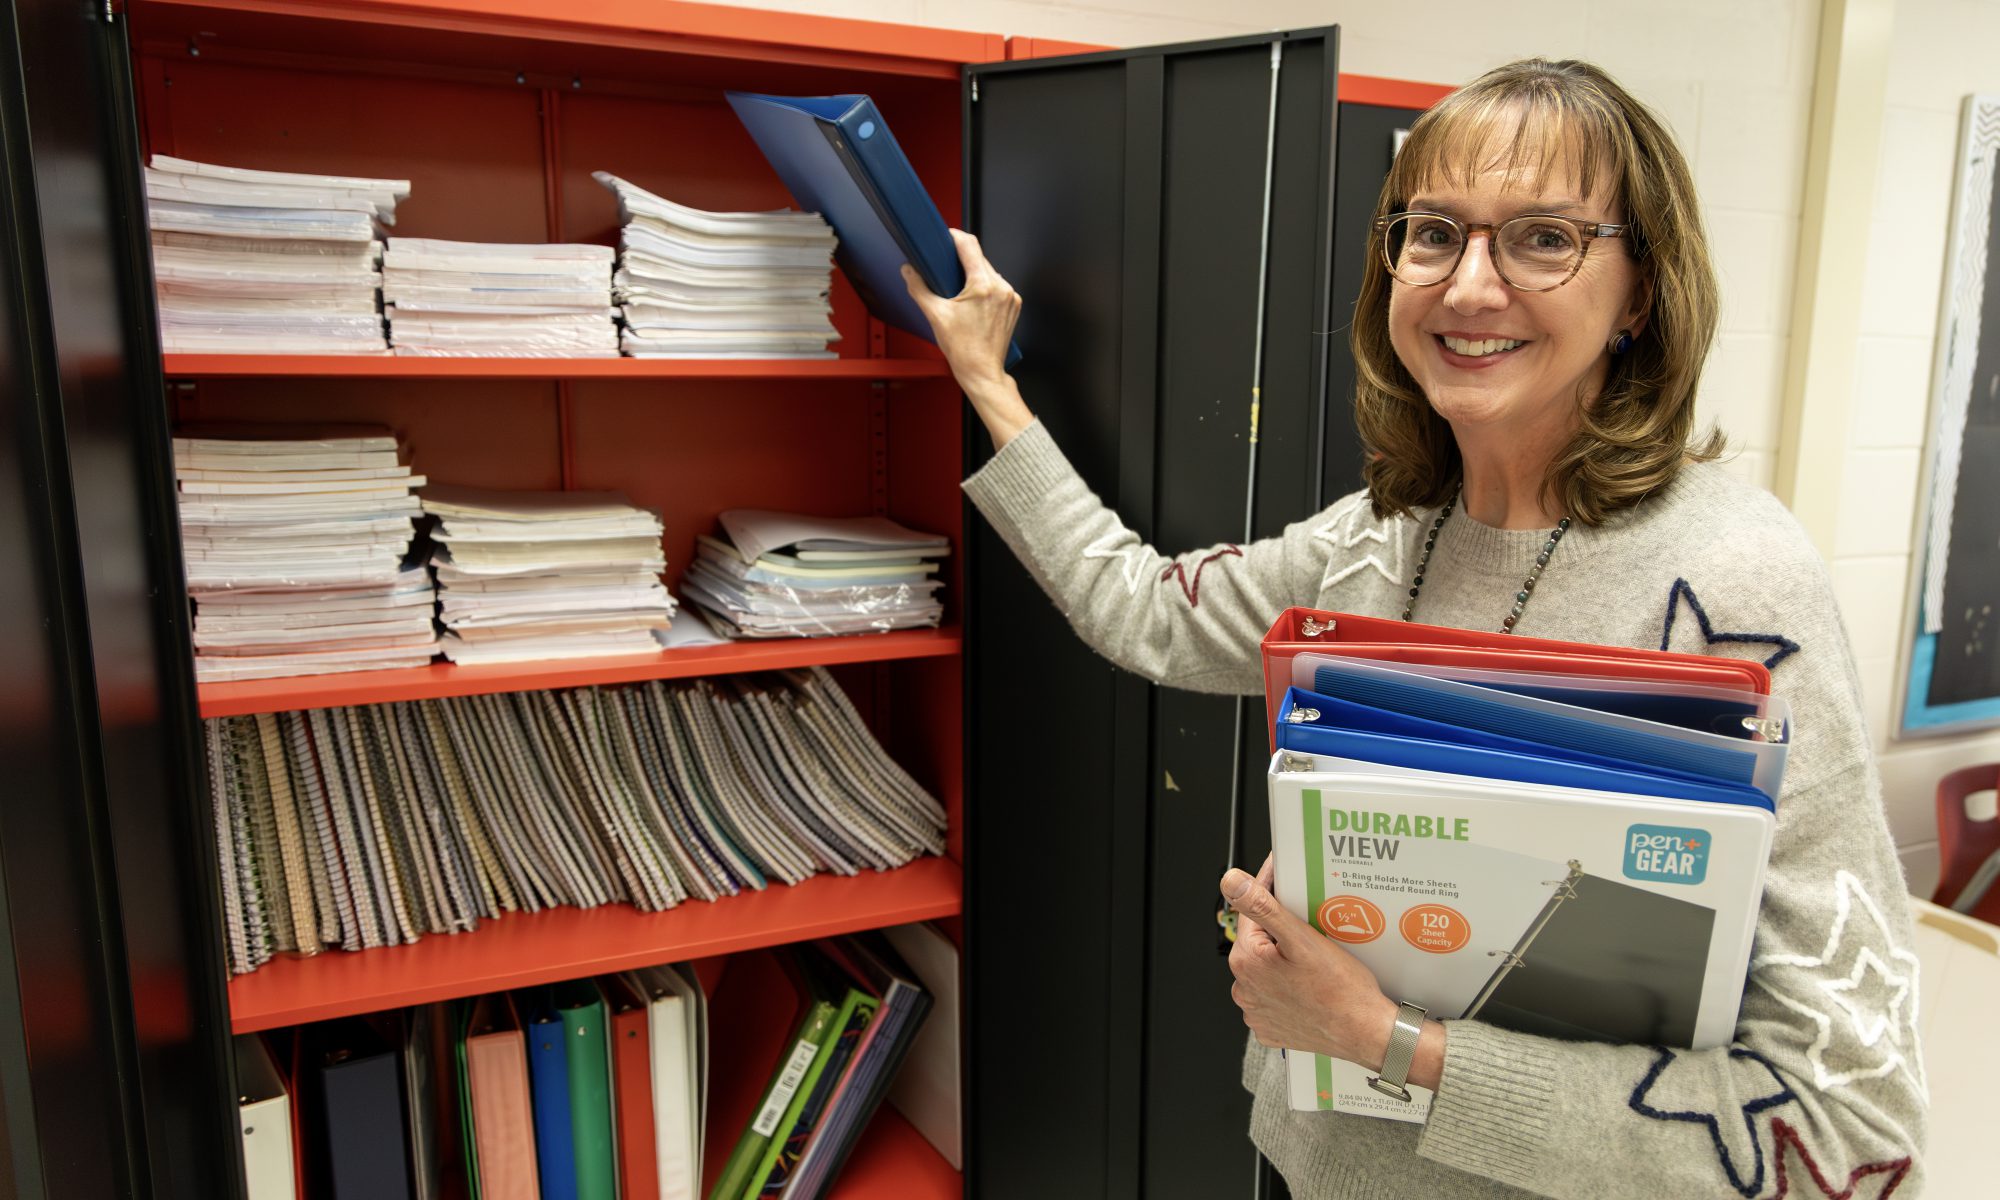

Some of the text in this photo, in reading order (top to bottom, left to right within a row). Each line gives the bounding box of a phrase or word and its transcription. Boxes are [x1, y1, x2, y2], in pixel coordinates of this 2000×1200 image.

[1329, 809, 1470, 841] DURABLE
[1328, 835, 1400, 861] VIEW
[1342, 872, 1457, 889] D-Ring Holds More Sheets
[1342, 880, 1459, 899] than Standard Round Ring
[1420, 913, 1450, 929] 120
[1417, 936, 1453, 947] Capacity
[1422, 928, 1446, 938] Sheet
